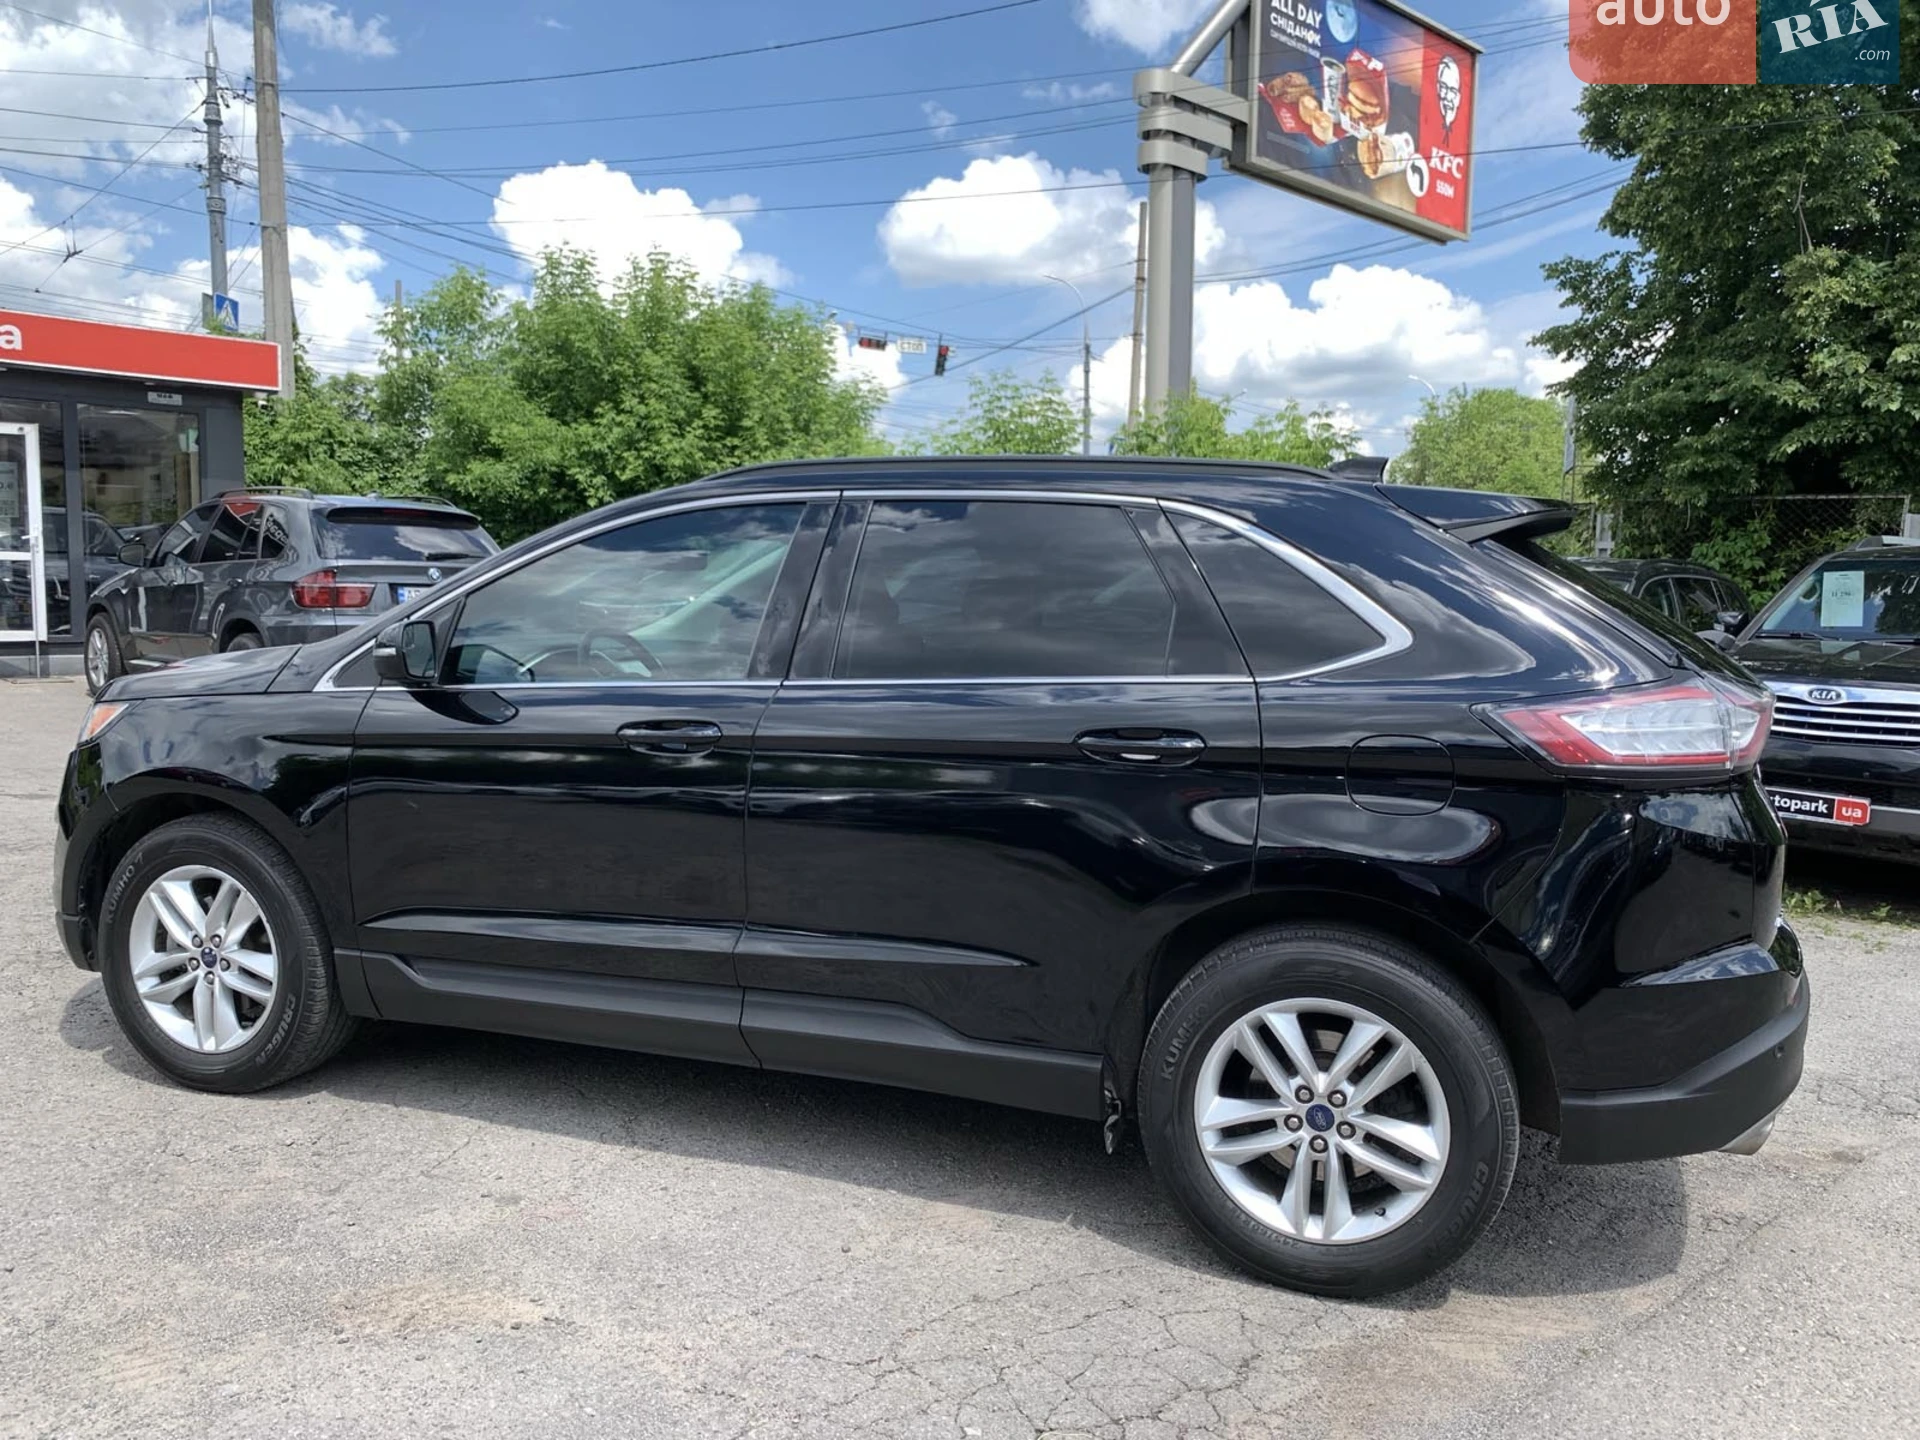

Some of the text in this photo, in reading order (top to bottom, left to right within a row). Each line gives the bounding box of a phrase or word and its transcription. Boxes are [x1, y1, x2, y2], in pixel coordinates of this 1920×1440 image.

[1297, 3, 1322, 29] DAY
[1429, 145, 1463, 180] KFC
[1811, 690, 1836, 700] KIA
[1770, 795, 1862, 818] topark ua
